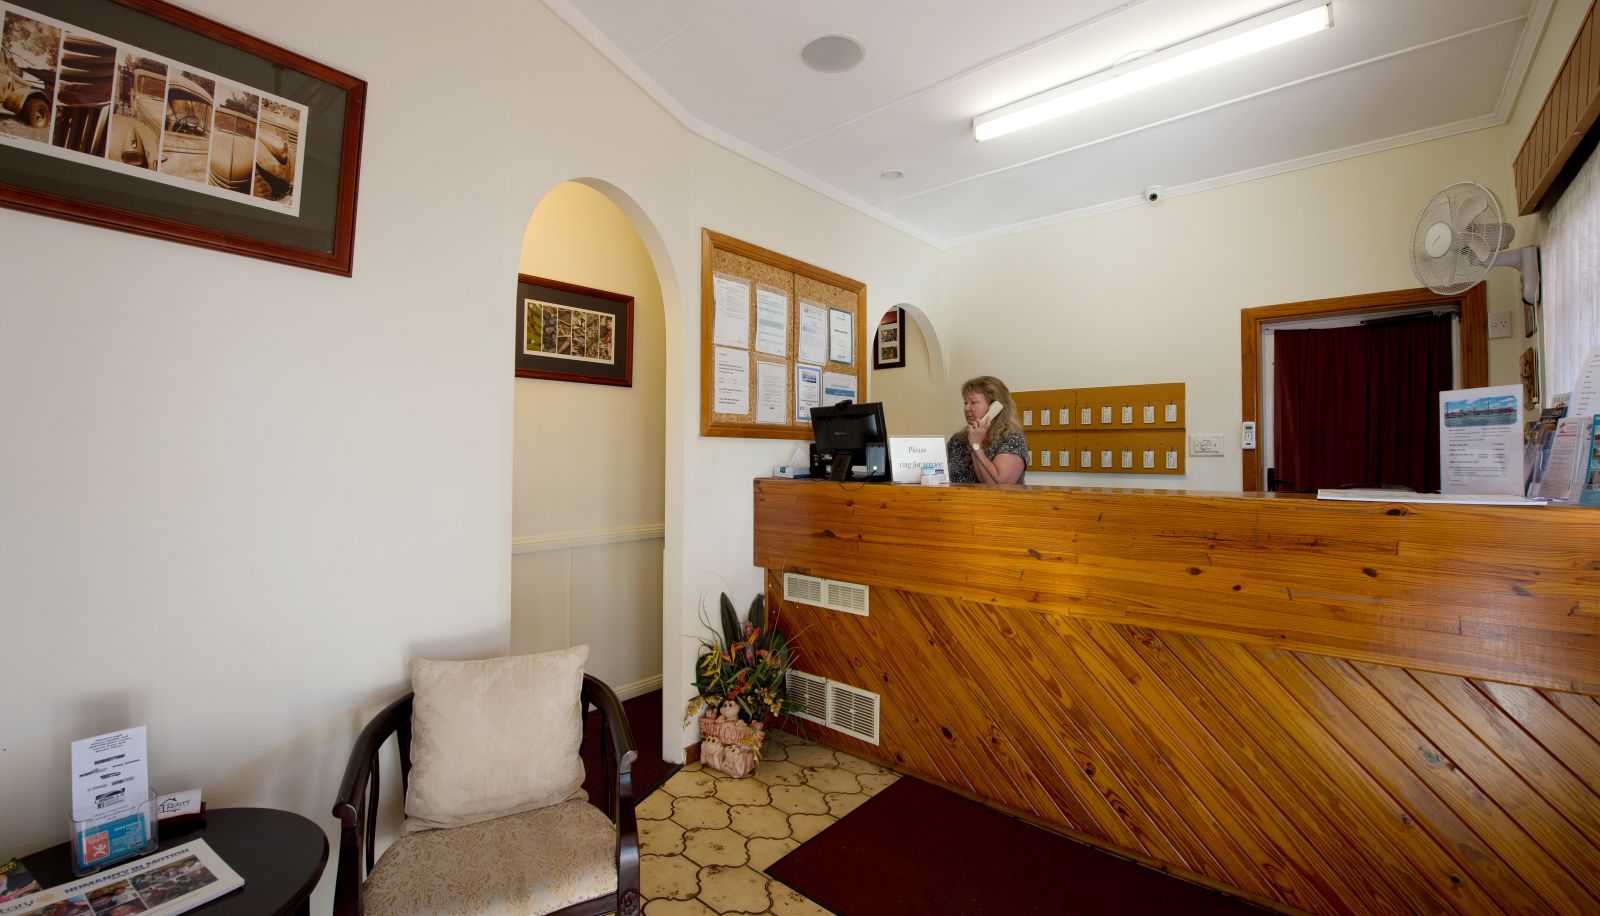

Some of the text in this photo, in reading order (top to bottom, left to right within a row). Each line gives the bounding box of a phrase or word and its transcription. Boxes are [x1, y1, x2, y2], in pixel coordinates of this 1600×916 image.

[908, 446, 927, 454] Please
[900, 460, 912, 470] ring
[913, 460, 921, 470] for
[64, 848, 190, 894] HUMANITY IN MOTION
